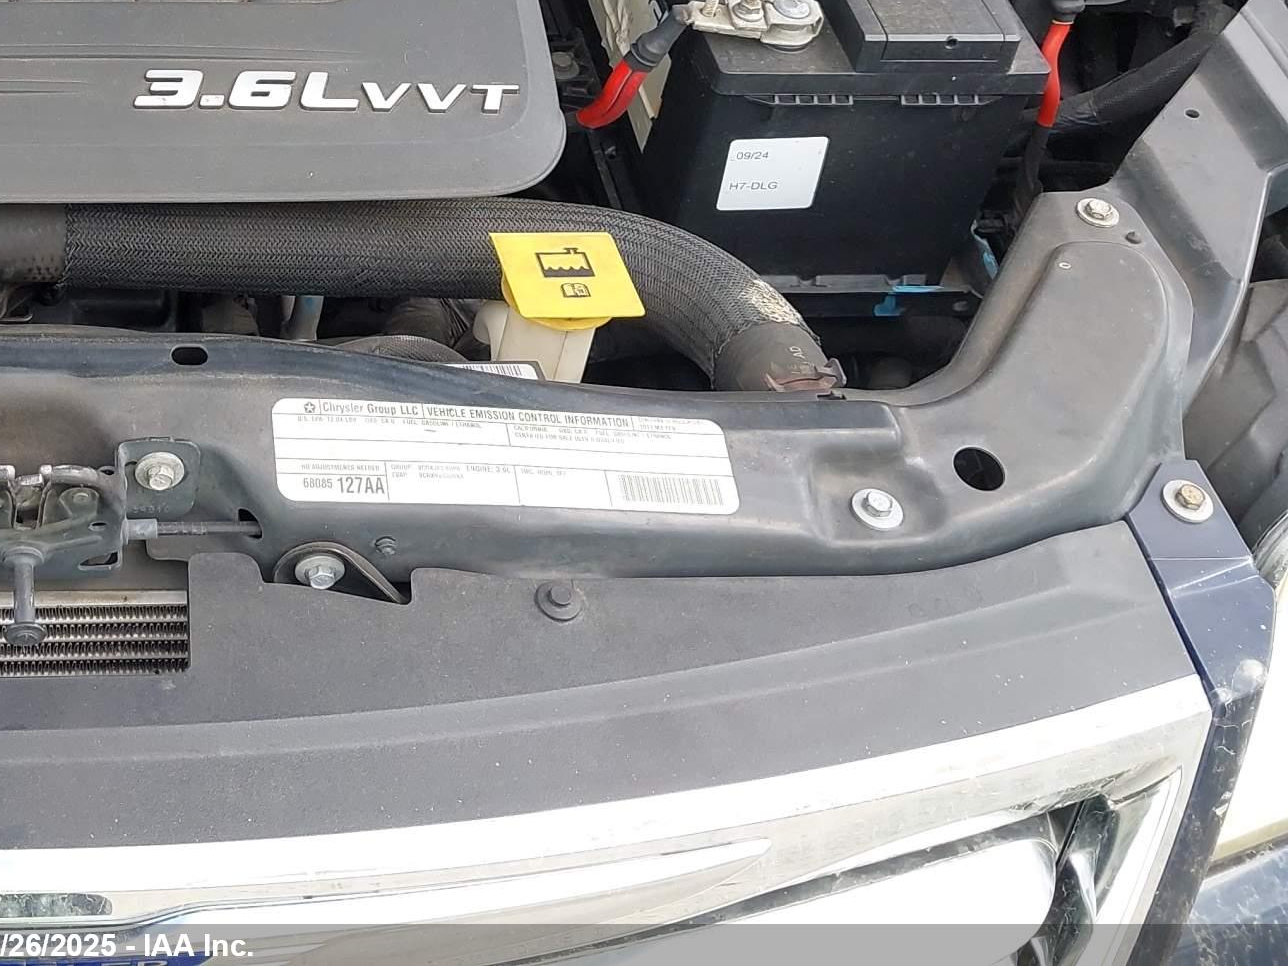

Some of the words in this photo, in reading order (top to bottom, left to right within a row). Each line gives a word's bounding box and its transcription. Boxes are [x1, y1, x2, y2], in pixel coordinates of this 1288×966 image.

[133, 68, 359, 111] 3.6L
[361, 81, 521, 115] VVT
[736, 151, 769, 160] 09/24
[729, 181, 778, 191] H7-DLG
[323, 401, 364, 414] Chrysler
[367, 403, 396, 415] Group
[400, 405, 418, 415] LLC
[426, 406, 466, 418] VEHICLE
[470, 409, 515, 421] EMISSION
[518, 412, 562, 424] CONTROL
[565, 415, 629, 428] INFORMATION
[303, 477, 333, 489] 68085
[337, 476, 386, 494] 127AA
